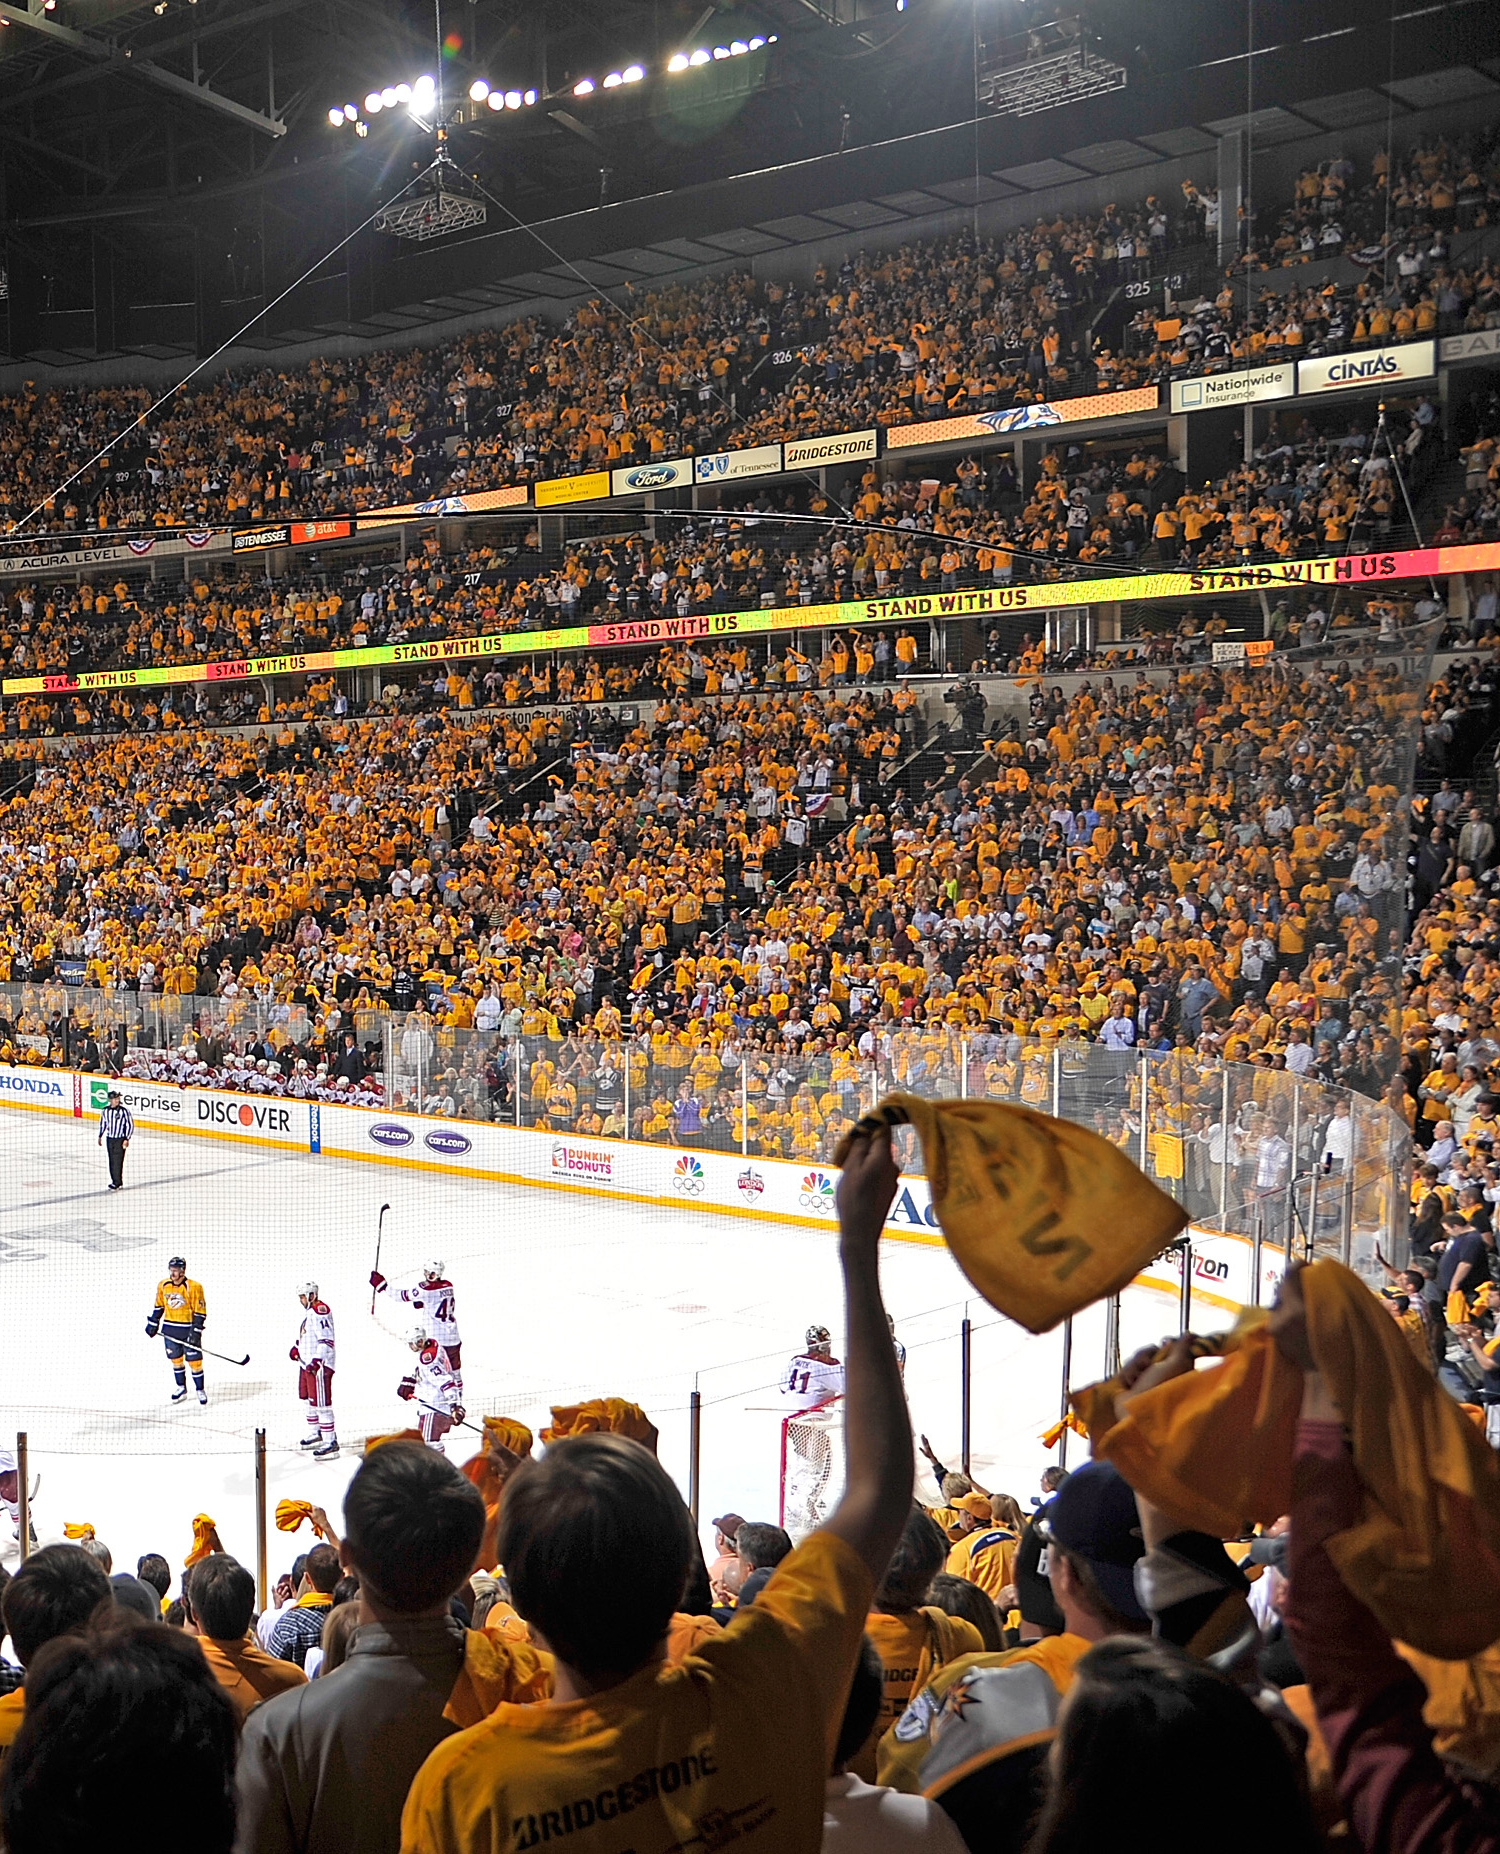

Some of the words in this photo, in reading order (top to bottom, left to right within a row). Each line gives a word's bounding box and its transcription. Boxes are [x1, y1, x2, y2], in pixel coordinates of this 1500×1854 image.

[1125, 281, 1150, 298] 325
[772, 351, 792, 364] 326
[1205, 372, 1283, 393] Nationwide
[1205, 389, 1255, 404] Insurance
[787, 438, 874, 463] BRIDGESTONE
[635, 468, 668, 487] Ford
[739, 460, 779, 475] Tennessee
[317, 522, 337, 534] at&t
[20, 554, 70, 569] ACURA
[75, 548, 122, 563] LEVEL
[464, 573, 481, 587] 217
[1281, 559, 1351, 583] WITH
[1360, 556, 1396, 577] US
[866, 598, 932, 618] STAND
[939, 592, 993, 612] WITH
[1000, 589, 1027, 607] US
[607, 621, 660, 641] STAND
[666, 617, 710, 635] WITH
[714, 615, 738, 631] US
[393, 644, 438, 660] STAND
[442, 640, 479, 656] WITH
[482, 637, 502, 651] US
[215, 662, 252, 677] STAND
[256, 659, 287, 674] WITH
[290, 656, 306, 670] US
[1403, 656, 1433, 671] 114
[42, 675, 81, 690] STAND
[85, 673, 119, 686] WITH
[120, 672, 137, 684] US
[92, 1088, 181, 1112] eterprise
[198, 1098, 291, 1132] DISCOVER
[311, 1104, 320, 1143] Reebok
[372, 1128, 409, 1142] cars.com
[428, 1135, 466, 1149] cars.com
[568, 1158, 612, 1175] DONUTS
[1161, 1243, 1230, 1279] veizon
[511, 1745, 719, 1851] BRIDGESTONE
